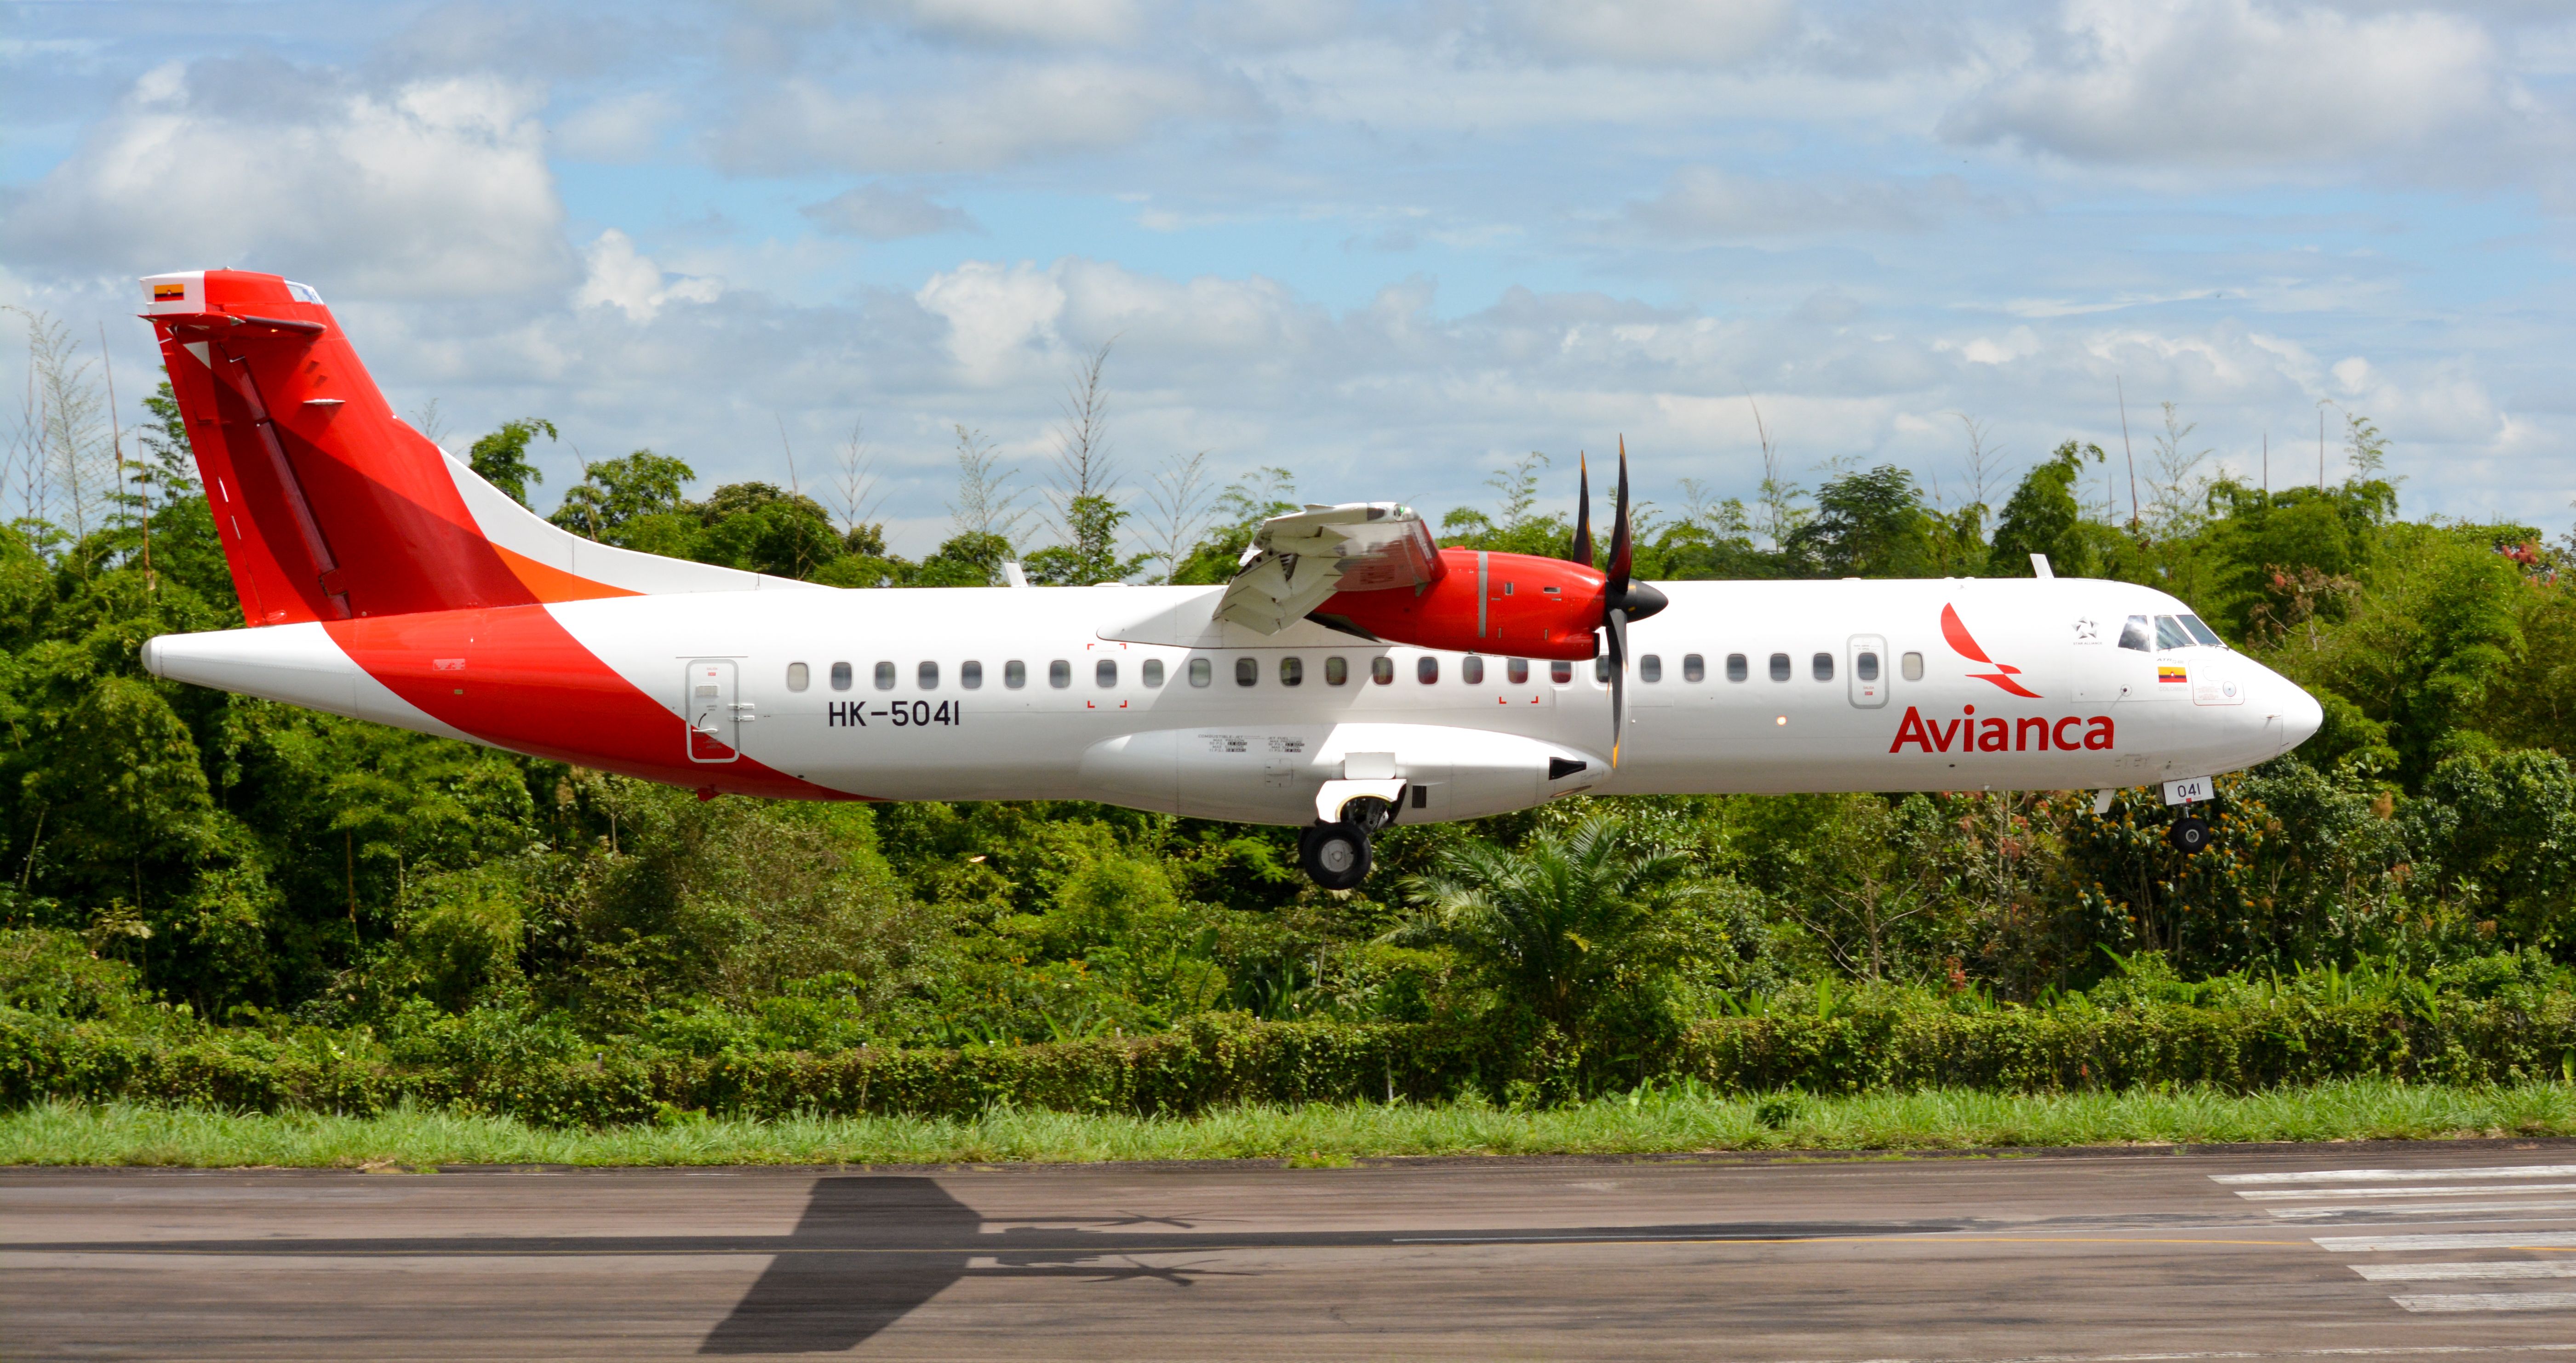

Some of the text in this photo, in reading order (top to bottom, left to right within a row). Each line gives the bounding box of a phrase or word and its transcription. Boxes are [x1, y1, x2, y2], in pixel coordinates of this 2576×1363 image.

[830, 701, 959, 727] HK-5041
[1889, 704, 2114, 753] Avianca
[2177, 783, 2201, 798] 041
